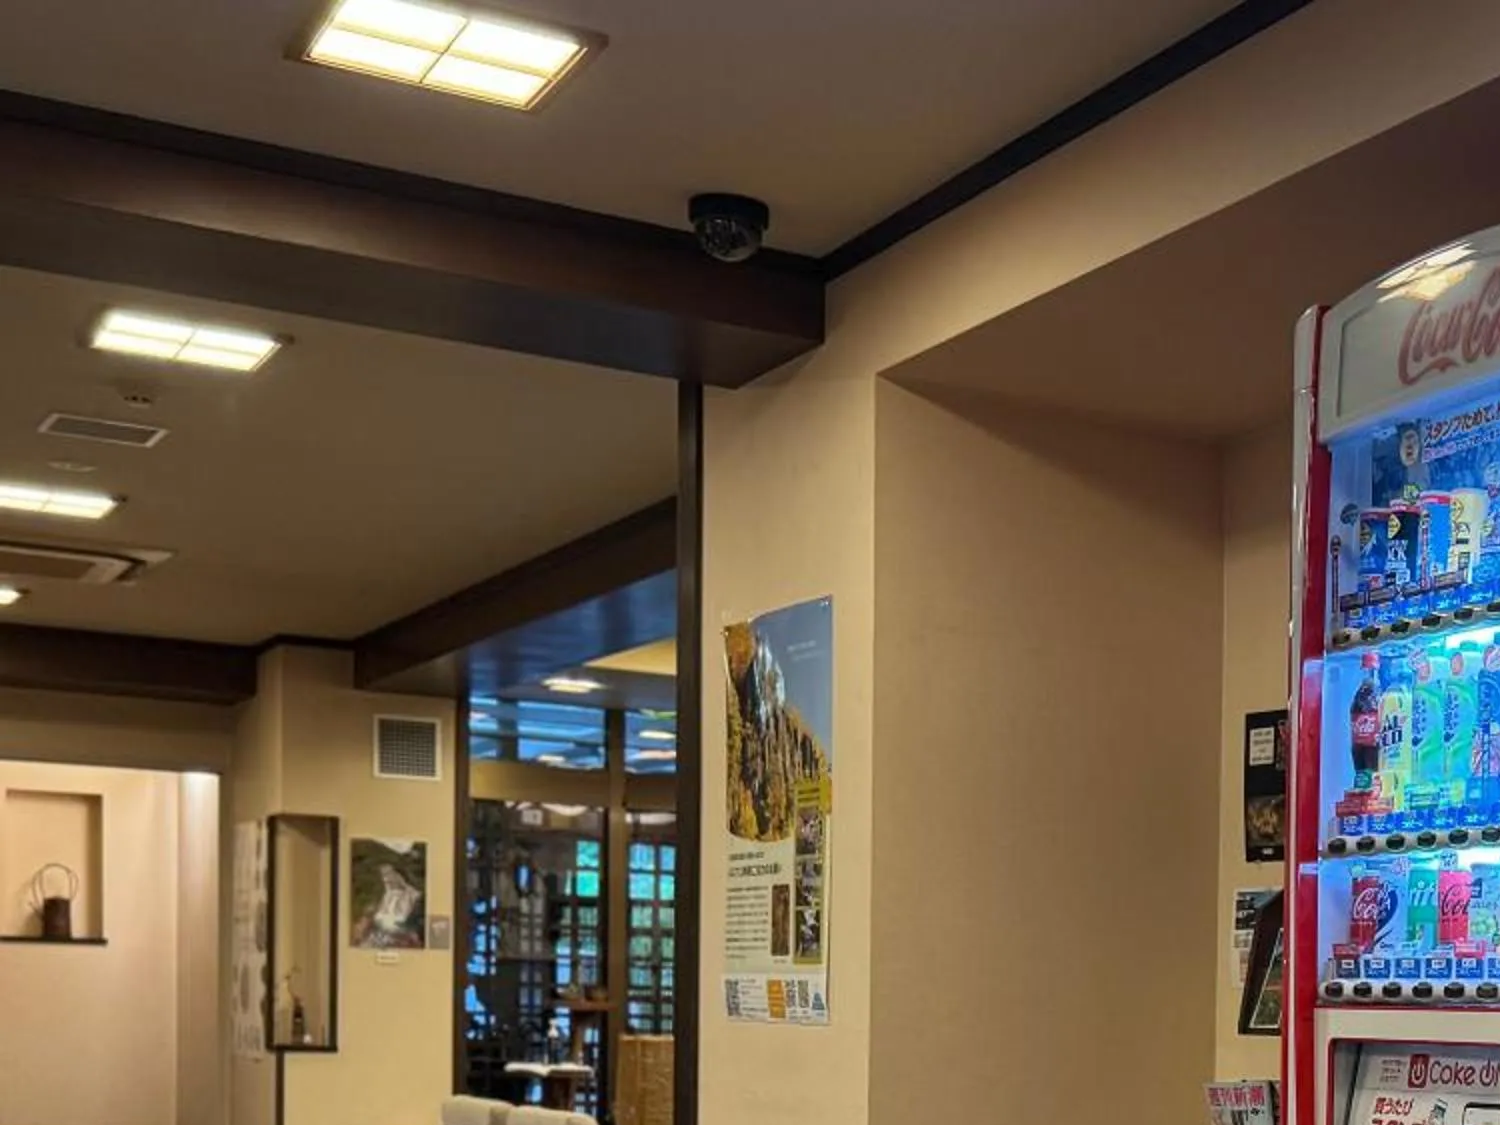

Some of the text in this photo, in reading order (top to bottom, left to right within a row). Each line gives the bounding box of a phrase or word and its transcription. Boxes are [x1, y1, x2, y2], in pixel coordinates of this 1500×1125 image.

[1430, 1061, 1475, 1086] Coke
[1374, 1097, 1415, 1116] 買うたび
